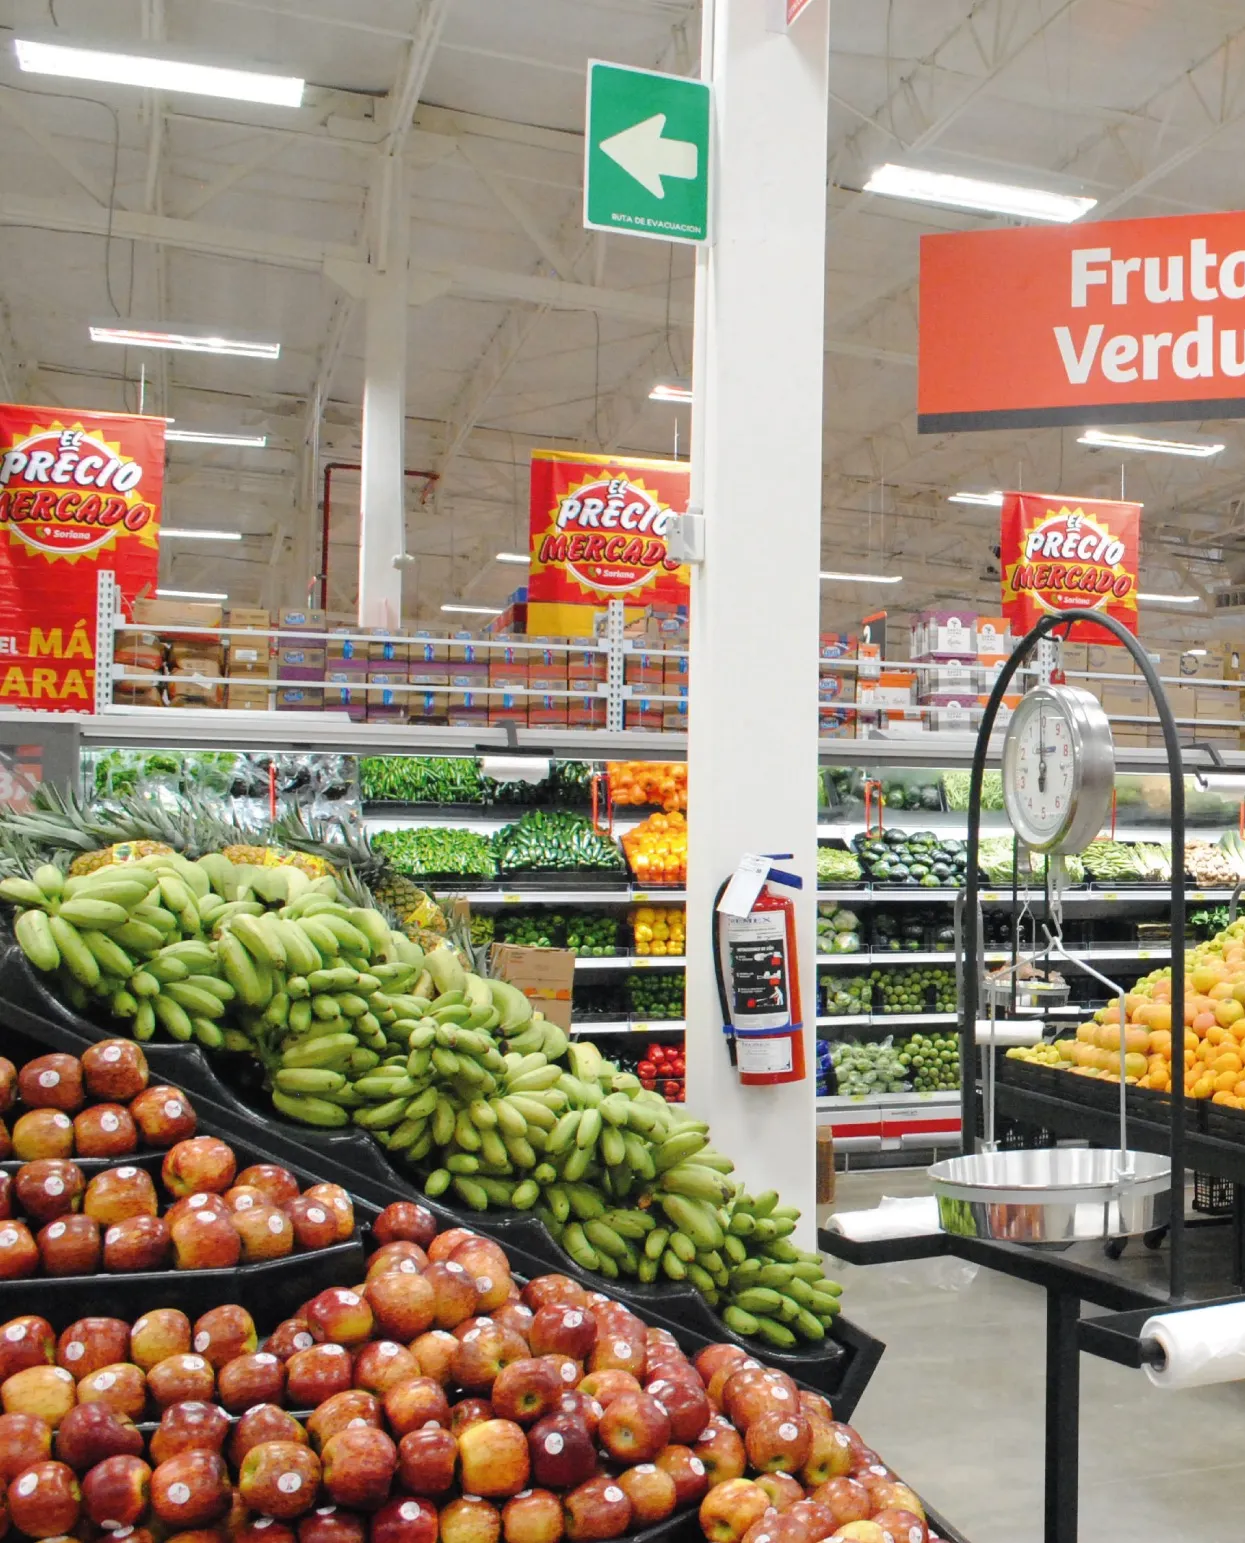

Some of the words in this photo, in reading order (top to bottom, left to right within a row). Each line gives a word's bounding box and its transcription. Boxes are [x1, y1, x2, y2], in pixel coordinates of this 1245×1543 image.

[611, 213, 632, 222] RUTA
[634, 217, 646, 225] DE
[60, 430, 83, 446] EL
[1, 450, 143, 492] PRECIO
[608, 479, 628, 494] EL
[1067, 515, 1083, 529] EL
[53, 529, 91, 540] Soriana
[1025, 531, 1125, 565] PRECIO
[603, 569, 635, 579] Soriana
[1011, 564, 1132, 598] MERCADO
